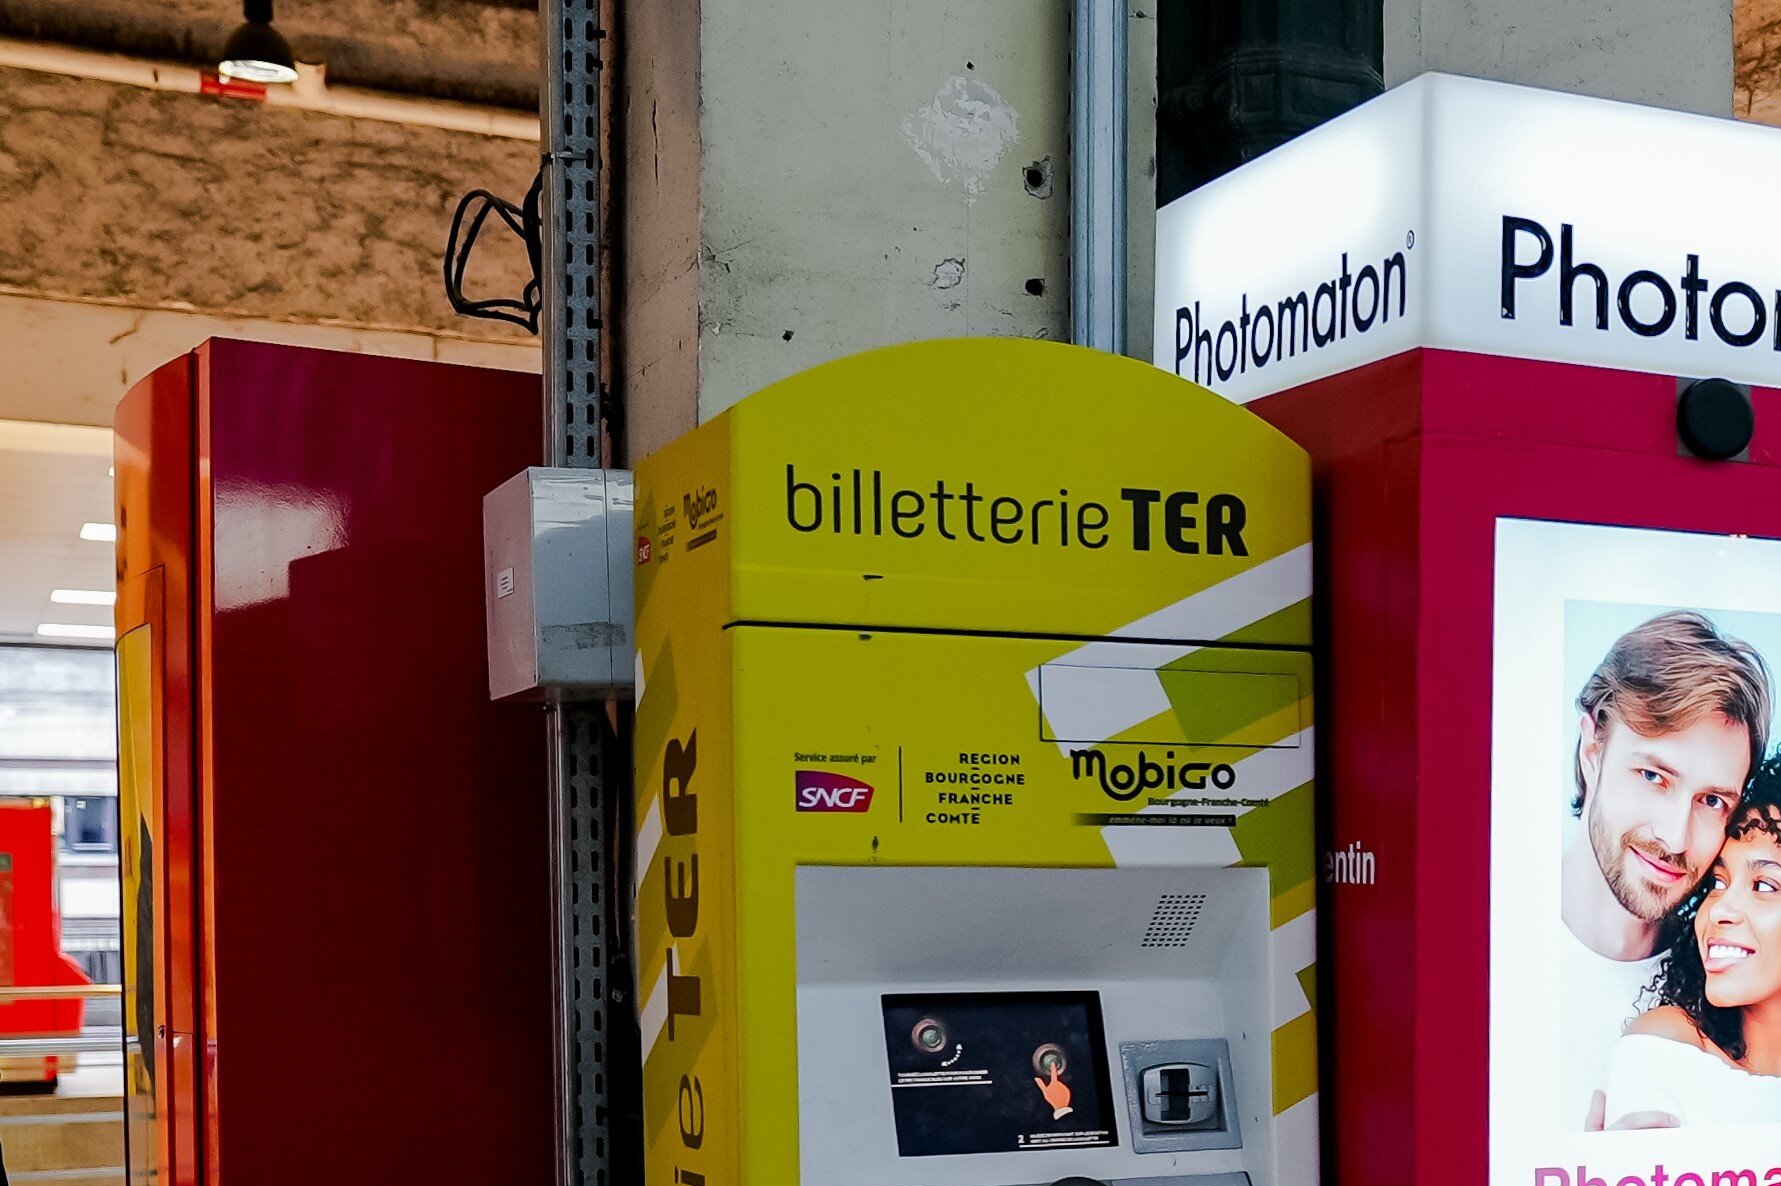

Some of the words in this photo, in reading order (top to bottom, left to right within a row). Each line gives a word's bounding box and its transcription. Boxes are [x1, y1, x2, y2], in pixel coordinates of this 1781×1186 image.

[786, 464, 1109, 549] billetterie
[1121, 487, 1250, 556] TER
[794, 752, 827, 763] Service
[829, 753, 859, 764] assuré
[861, 755, 877, 765] par
[925, 771, 1025, 785] BOURGOGNE
[798, 787, 868, 808] SNCF
[938, 792, 1013, 805] FRANCHE
[662, 727, 700, 1041] TER
